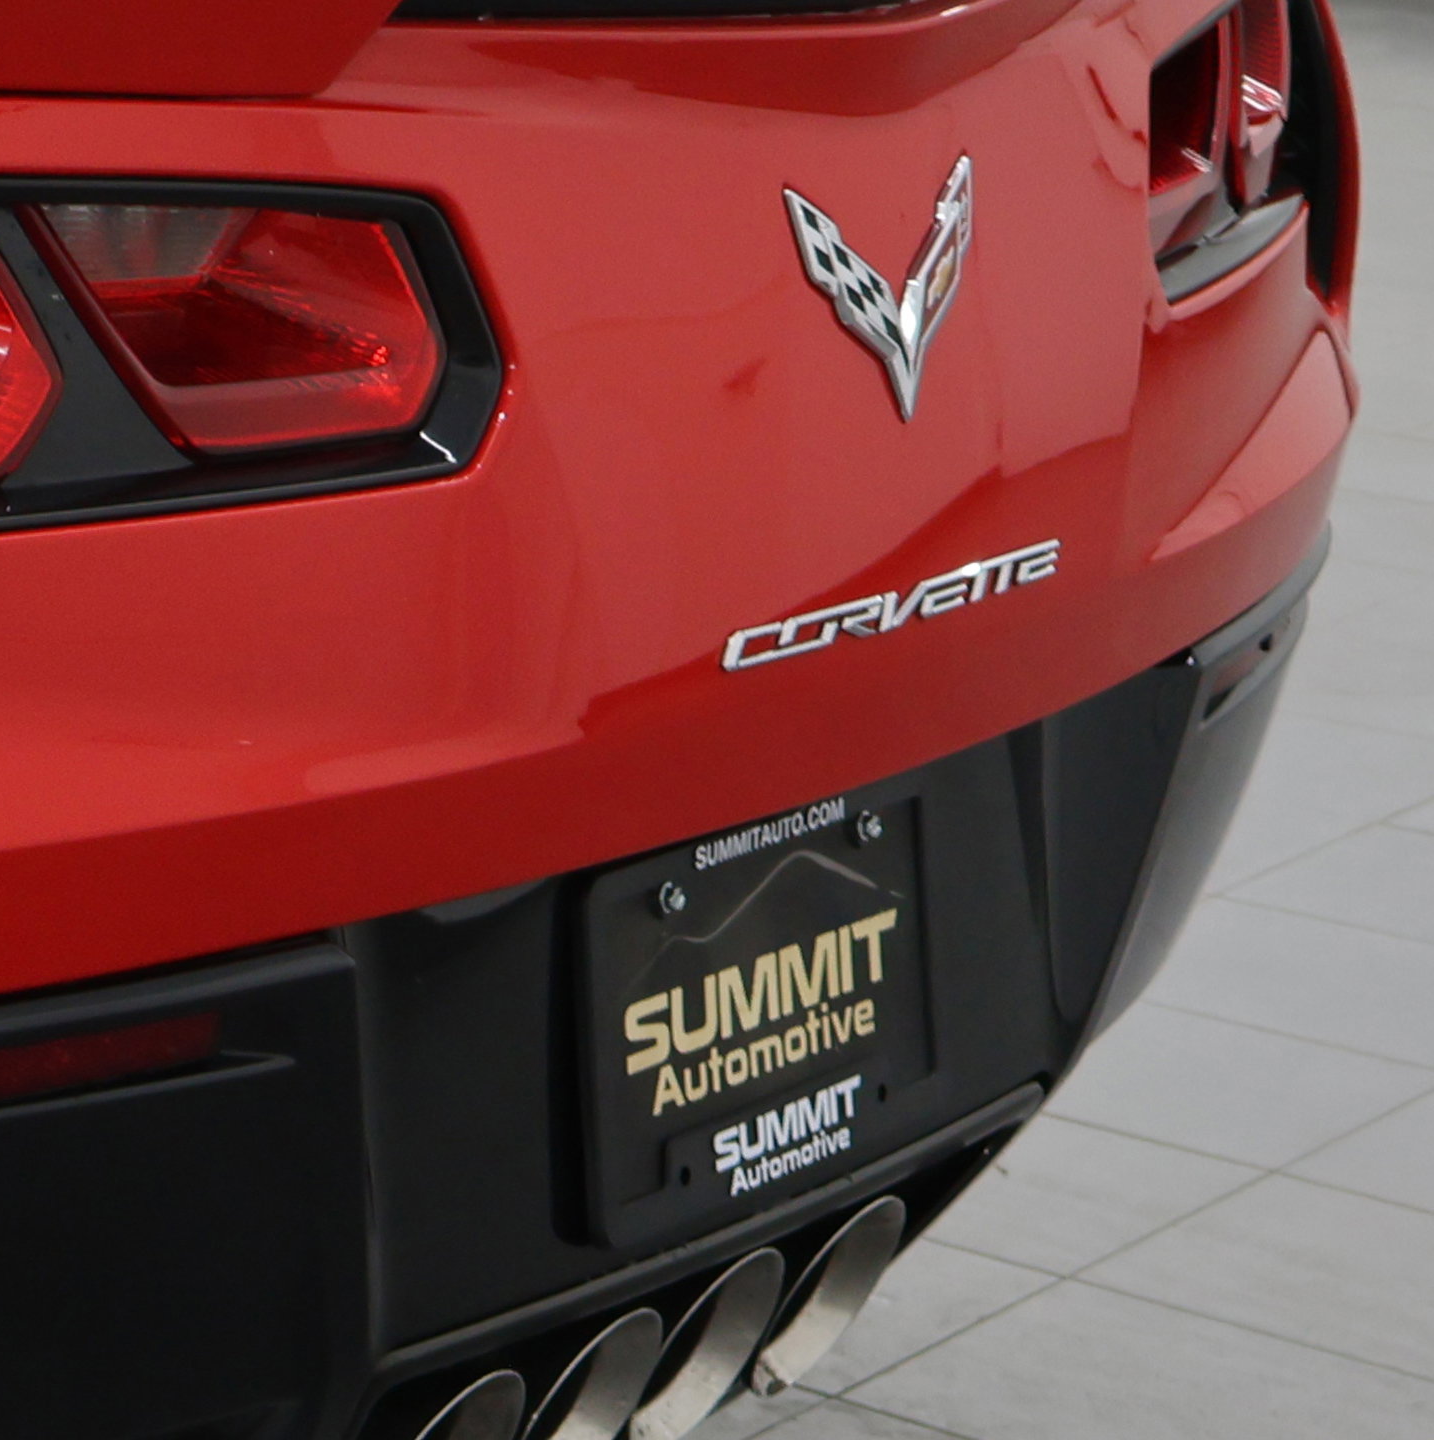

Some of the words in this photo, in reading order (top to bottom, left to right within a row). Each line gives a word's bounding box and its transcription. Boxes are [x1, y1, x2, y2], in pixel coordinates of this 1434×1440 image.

[721, 538, 1061, 672] CORVETTE
[694, 797, 846, 871] SUMMITAUTO.COM
[624, 907, 898, 1076] SUMMIT
[652, 998, 876, 1117] Automotive
[713, 1074, 862, 1173] SUMMIT
[729, 1127, 851, 1198] Automotive
